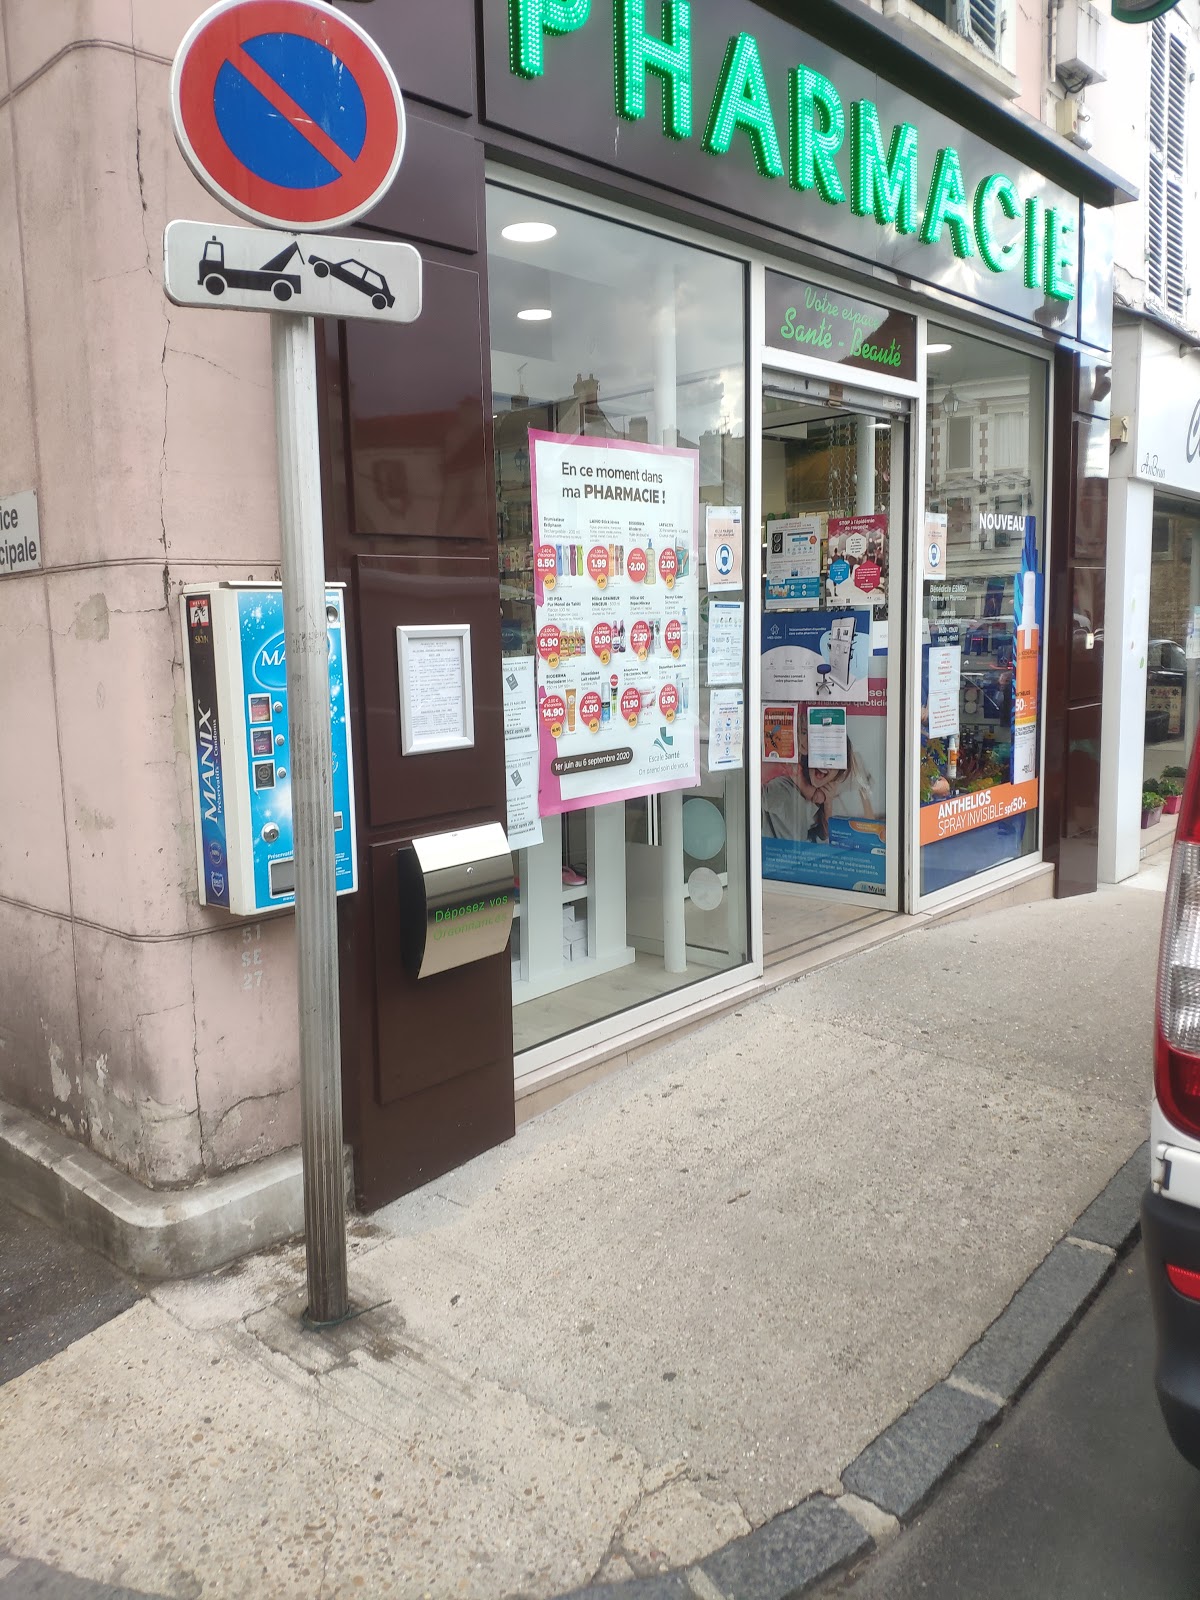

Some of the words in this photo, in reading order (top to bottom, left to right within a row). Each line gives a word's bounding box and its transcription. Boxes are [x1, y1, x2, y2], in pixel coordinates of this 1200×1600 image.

[804, 286, 839, 317] Votre
[780, 307, 833, 349] Santé
[850, 327, 902, 367] Beauté
[561, 462, 577, 476] En
[579, 466, 594, 477] ce
[596, 467, 640, 481] moment
[641, 469, 664, 484] dans
[562, 487, 581, 498] ma
[584, 484, 660, 504] PHARMACIE
[979, 513, 1026, 531] NOUVEAU
[537, 558, 555, 568] 8.50
[591, 559, 607, 568] 1.99
[628, 562, 646, 571] -2.00
[661, 560, 675, 569] 2.00
[594, 635, 611, 645] 9.90
[633, 633, 648, 642] 2.20
[667, 631, 681, 640] 9.90
[540, 637, 559, 647] 6.90
[622, 699, 639, 709] 11.90
[661, 696, 676, 705] 6.90
[542, 707, 564, 718] 14.90
[581, 704, 599, 714] 4.90
[198, 699, 218, 824] MANIX
[554, 762, 564, 771] 1er
[563, 761, 575, 771] juin
[582, 759, 588, 767] 6
[587, 755, 616, 767] septembre
[616, 751, 630, 761] 2020
[648, 755, 665, 763] Escale
[664, 750, 680, 760] Santé
[938, 790, 992, 819] ANTHELIOS
[938, 815, 966, 836] SPRAY
[967, 802, 1004, 826] INVISIBLE
[435, 901, 485, 923] Déposez
[489, 895, 508, 907] vos
[243, 969, 263, 990] 27
